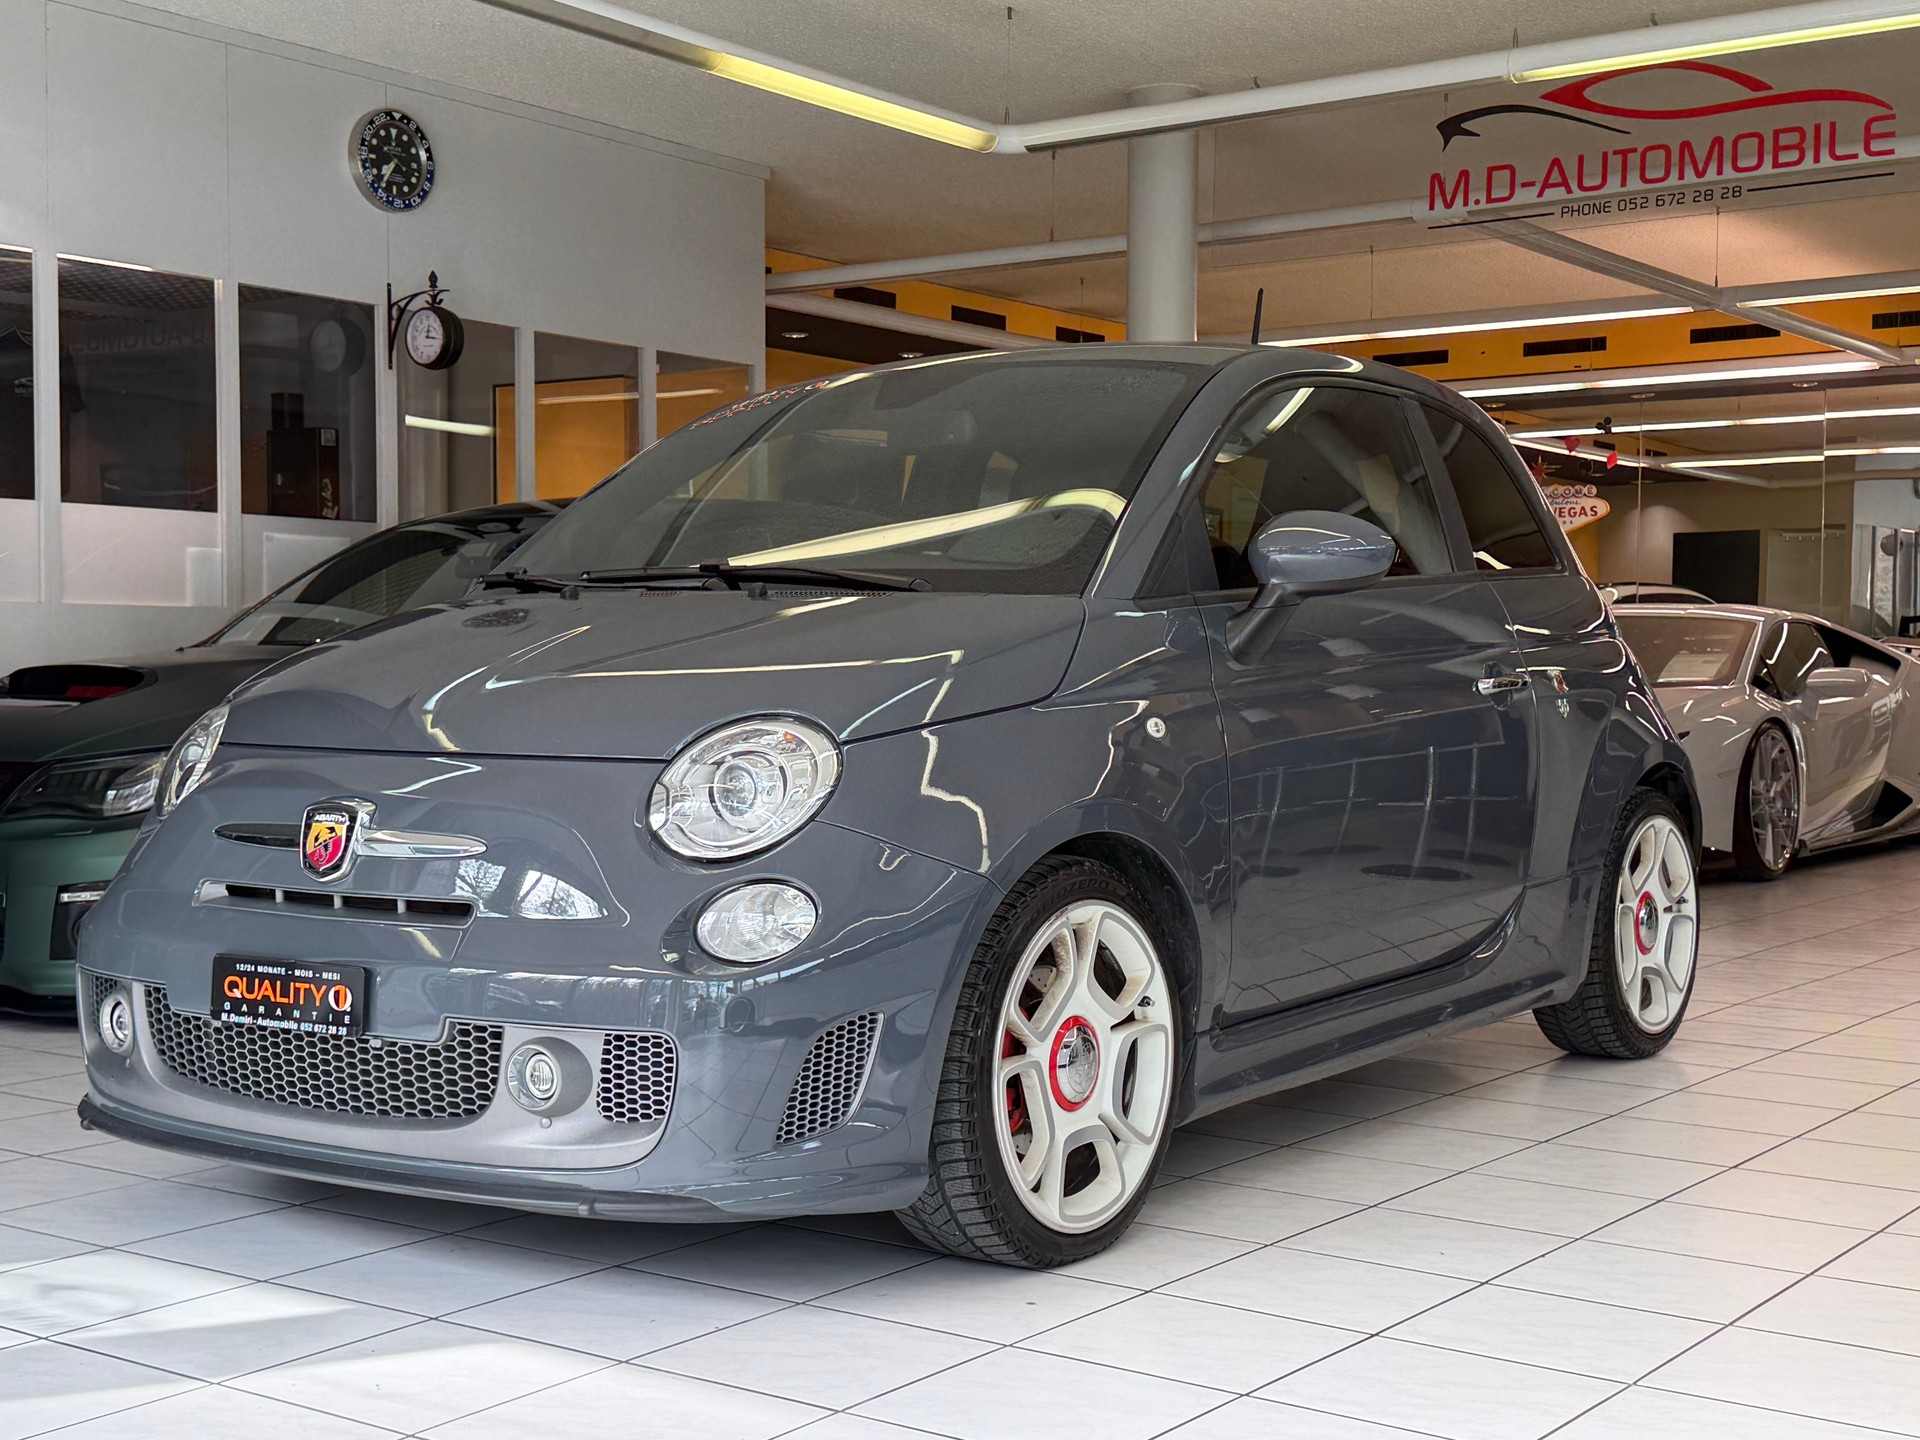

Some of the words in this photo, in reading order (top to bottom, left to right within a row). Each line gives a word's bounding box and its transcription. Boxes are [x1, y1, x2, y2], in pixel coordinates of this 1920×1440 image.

[373, 113, 387, 124] 22
[363, 126, 373, 139] 20
[409, 122, 417, 131] 2
[422, 140, 429, 149] 4
[1428, 113, 1897, 211] M.D-AUTOMOBILE
[1560, 200, 1612, 219] PHONE
[1617, 196, 1649, 211] 052
[1655, 192, 1686, 208] 672
[1692, 188, 1715, 204] 28
[1720, 185, 1743, 200] 28
[314, 814, 346, 822] ABARTH
[235, 963, 255, 972] 12/24
[257, 965, 286, 975] MONATE
[294, 969, 313, 978] MOIS
[322, 972, 341, 981] MESI
[224, 975, 328, 1007] QUALITY
[224, 1001, 351, 1025] GARANTIE
[300, 1022, 313, 1032] 052
[314, 1024, 327, 1034] 672
